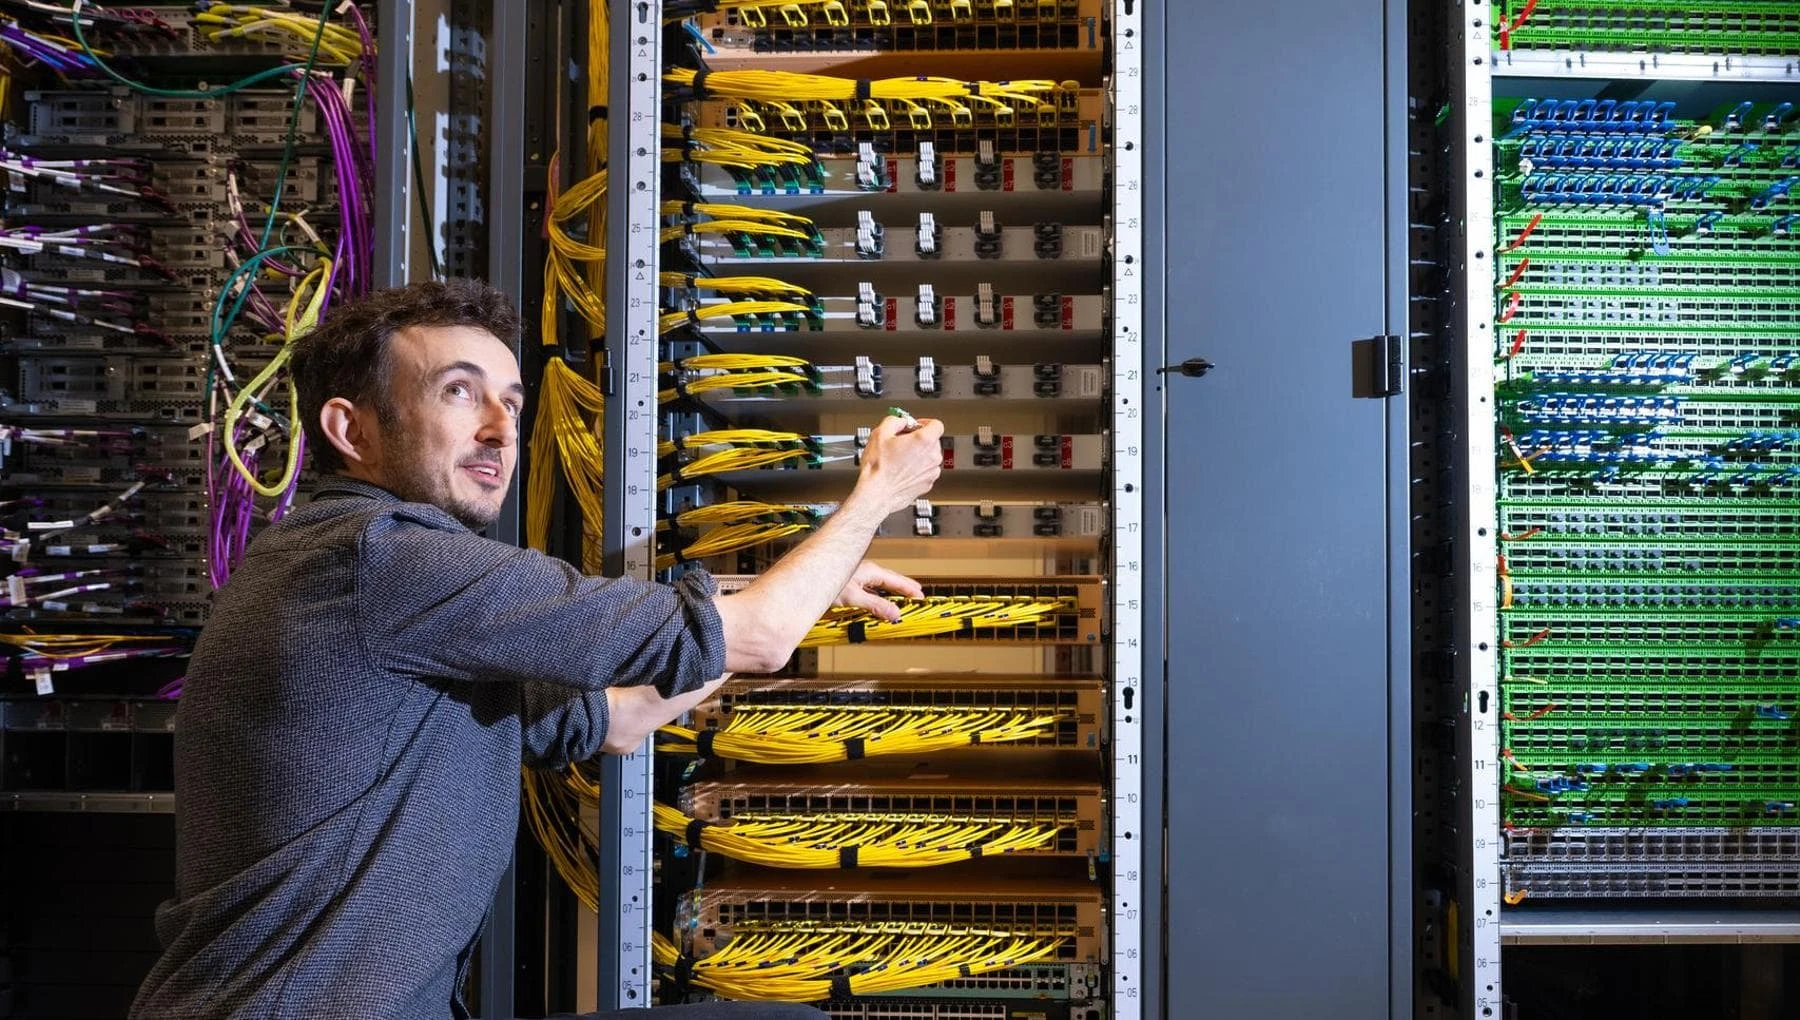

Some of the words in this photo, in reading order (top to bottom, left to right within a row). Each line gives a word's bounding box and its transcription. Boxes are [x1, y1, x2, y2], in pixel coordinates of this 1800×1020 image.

[1128, 105, 1138, 115] 28
[632, 112, 642, 122] 28
[631, 298, 641, 307] 23
[1128, 294, 1138, 304] 23
[630, 335, 640, 345] 22
[1128, 332, 1138, 342] 22
[630, 373, 640, 383] 21
[1128, 370, 1138, 380] 21
[629, 410, 639, 420] 20
[1128, 408, 1138, 418] 20
[628, 447, 638, 457] 19
[1128, 446, 1138, 456] 19
[627, 485, 637, 495] 18
[1128, 522, 1138, 533] 17
[1128, 561, 1138, 571] 16
[1473, 562, 1483, 572] 16
[1128, 600, 1138, 610] 15
[1473, 601, 1483, 611] 15
[1128, 638, 1138, 648] 14
[1128, 677, 1138, 687] 13
[1474, 720, 1484, 730] 12
[1128, 754, 1138, 764] 11
[1475, 760, 1485, 769] 11
[624, 789, 634, 799] 10
[1127, 793, 1138, 803] 10
[1475, 799, 1485, 809] 10
[623, 828, 633, 837] 09
[1475, 839, 1486, 848] 09
[623, 866, 633, 875] 08
[1127, 871, 1138, 881] 08
[1476, 878, 1486, 888] 08
[622, 904, 632, 913] 07
[1127, 909, 1138, 920] 07
[1476, 918, 1487, 928] 07
[622, 942, 632, 952] 06
[1127, 948, 1138, 959] 06
[1477, 958, 1487, 968] 06
[1477, 997, 1488, 1008] 05
